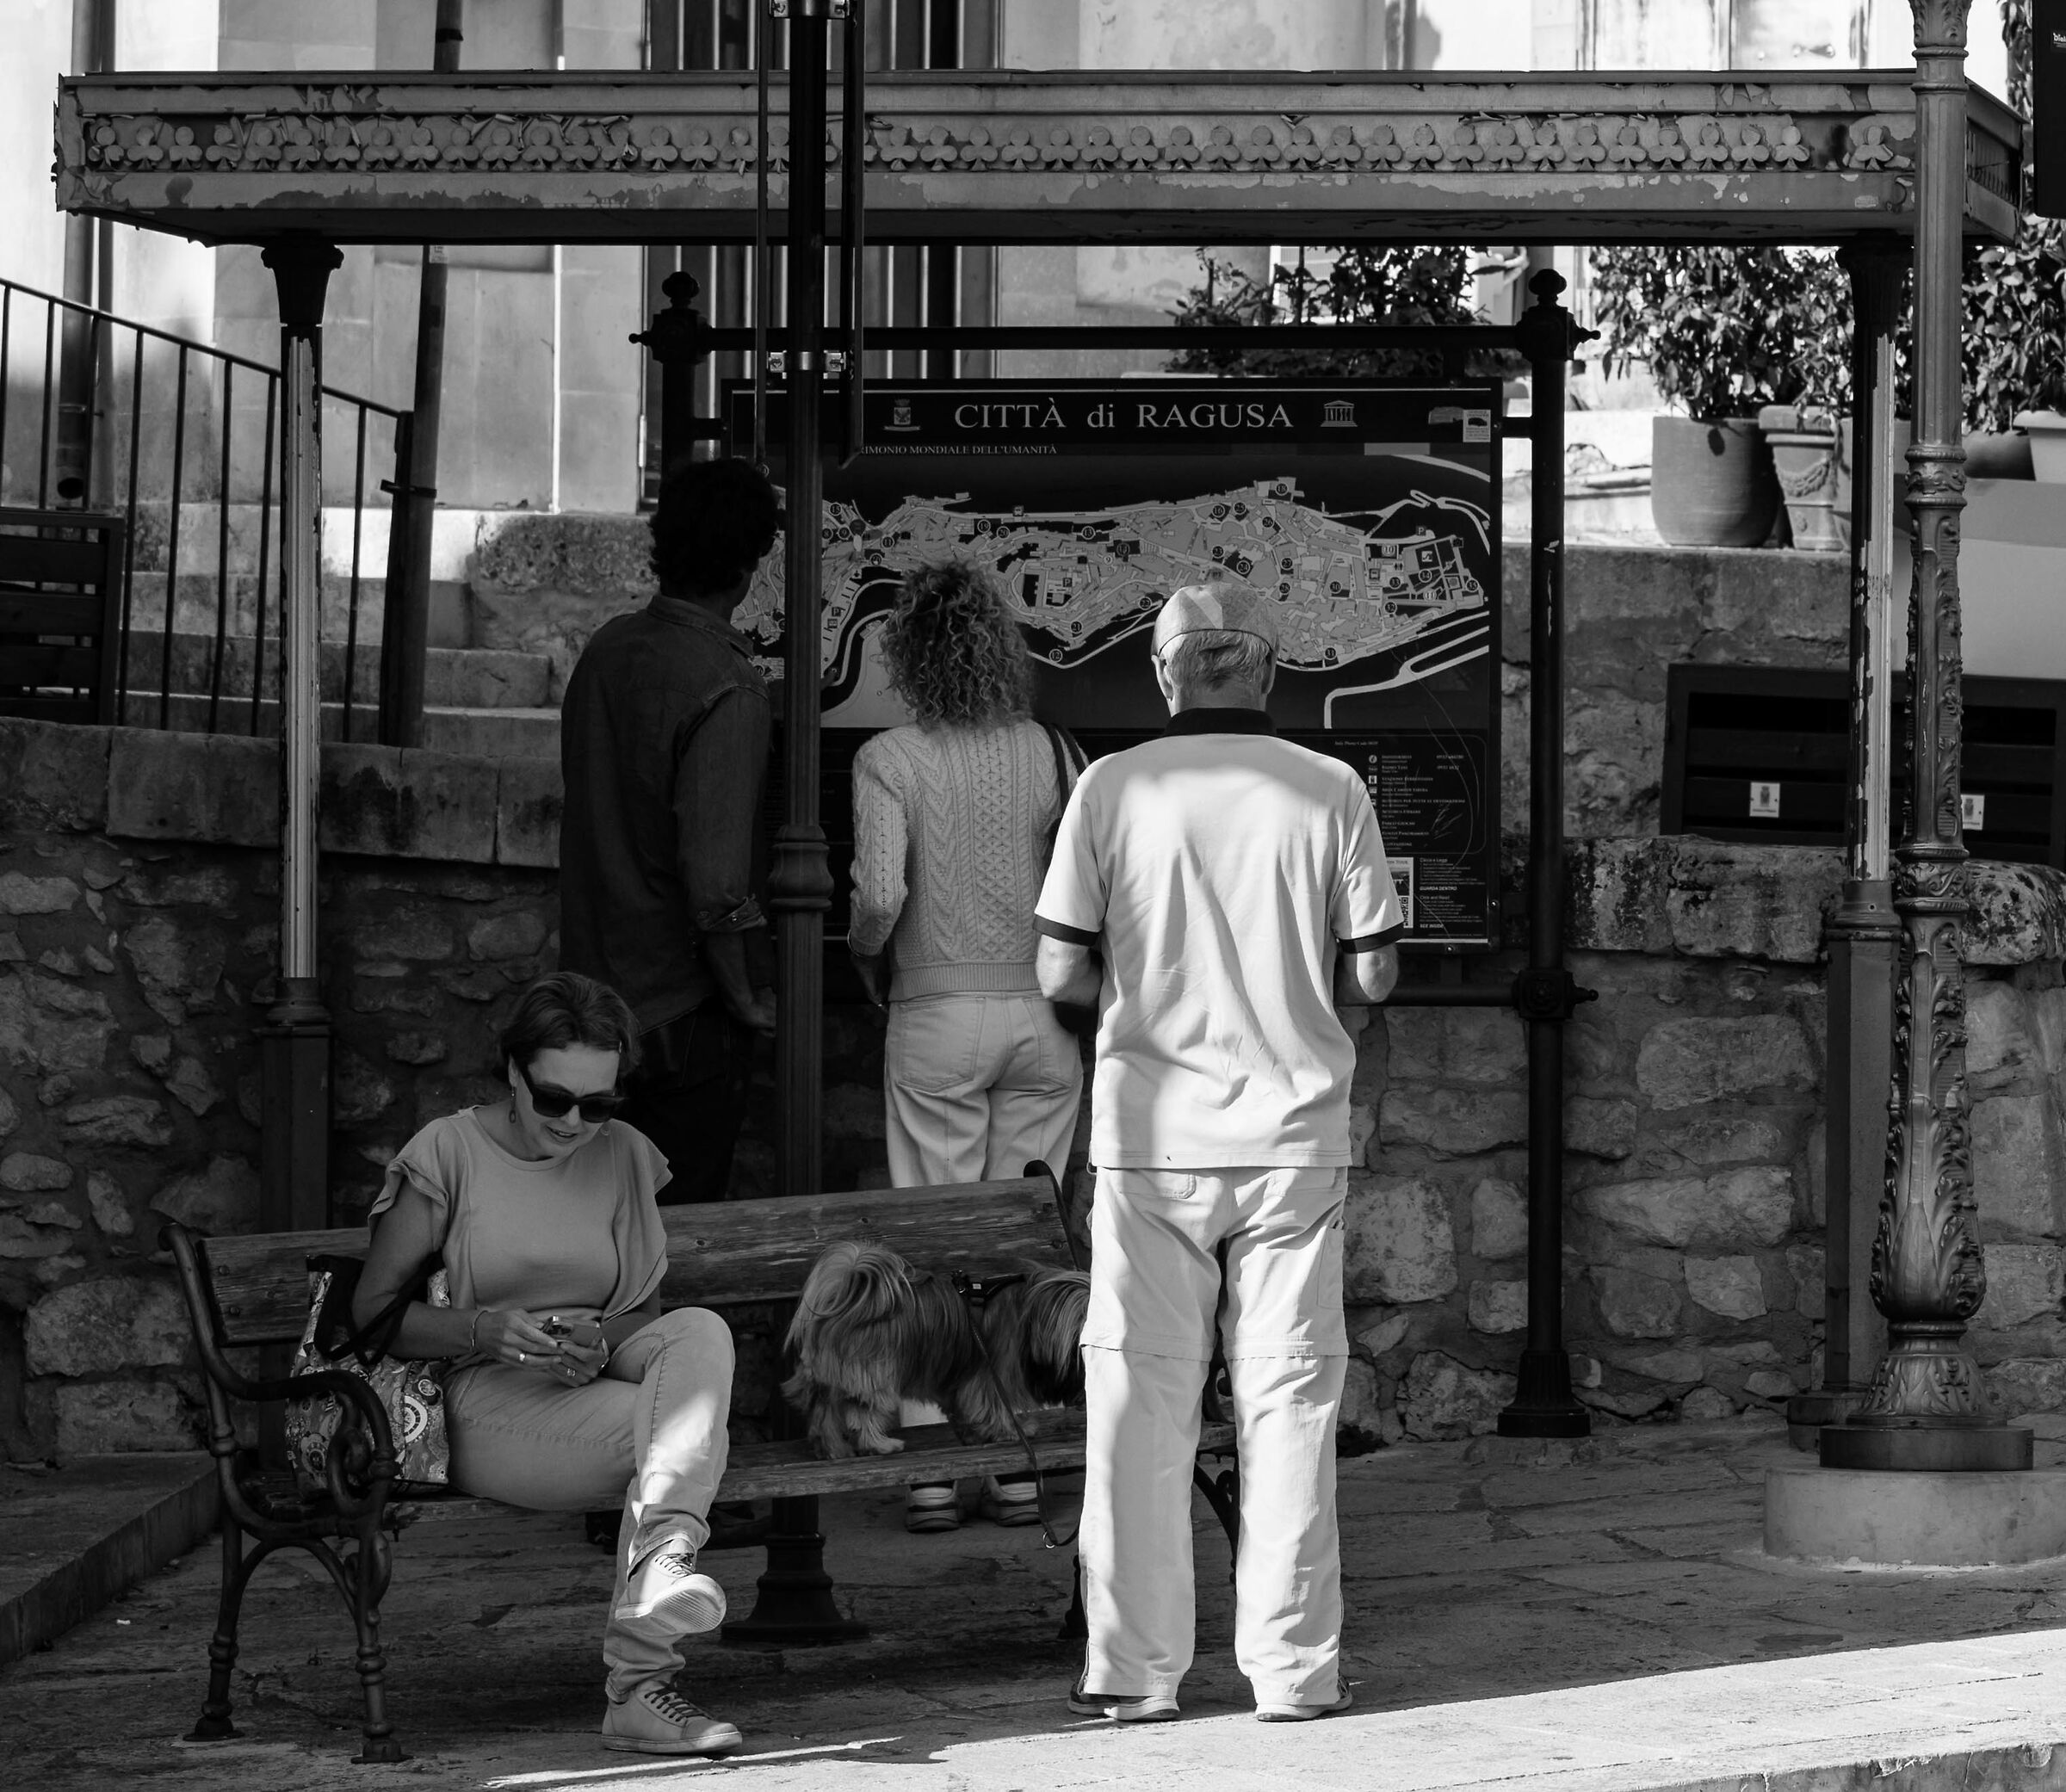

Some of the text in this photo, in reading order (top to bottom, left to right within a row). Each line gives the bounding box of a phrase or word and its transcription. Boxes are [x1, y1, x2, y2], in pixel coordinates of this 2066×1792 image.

[954, 397, 1294, 429] CITTÀ di RAGUSA
[909, 445, 970, 454] MONDIALE
[972, 443, 1057, 454] DELL'UMANITÀ
